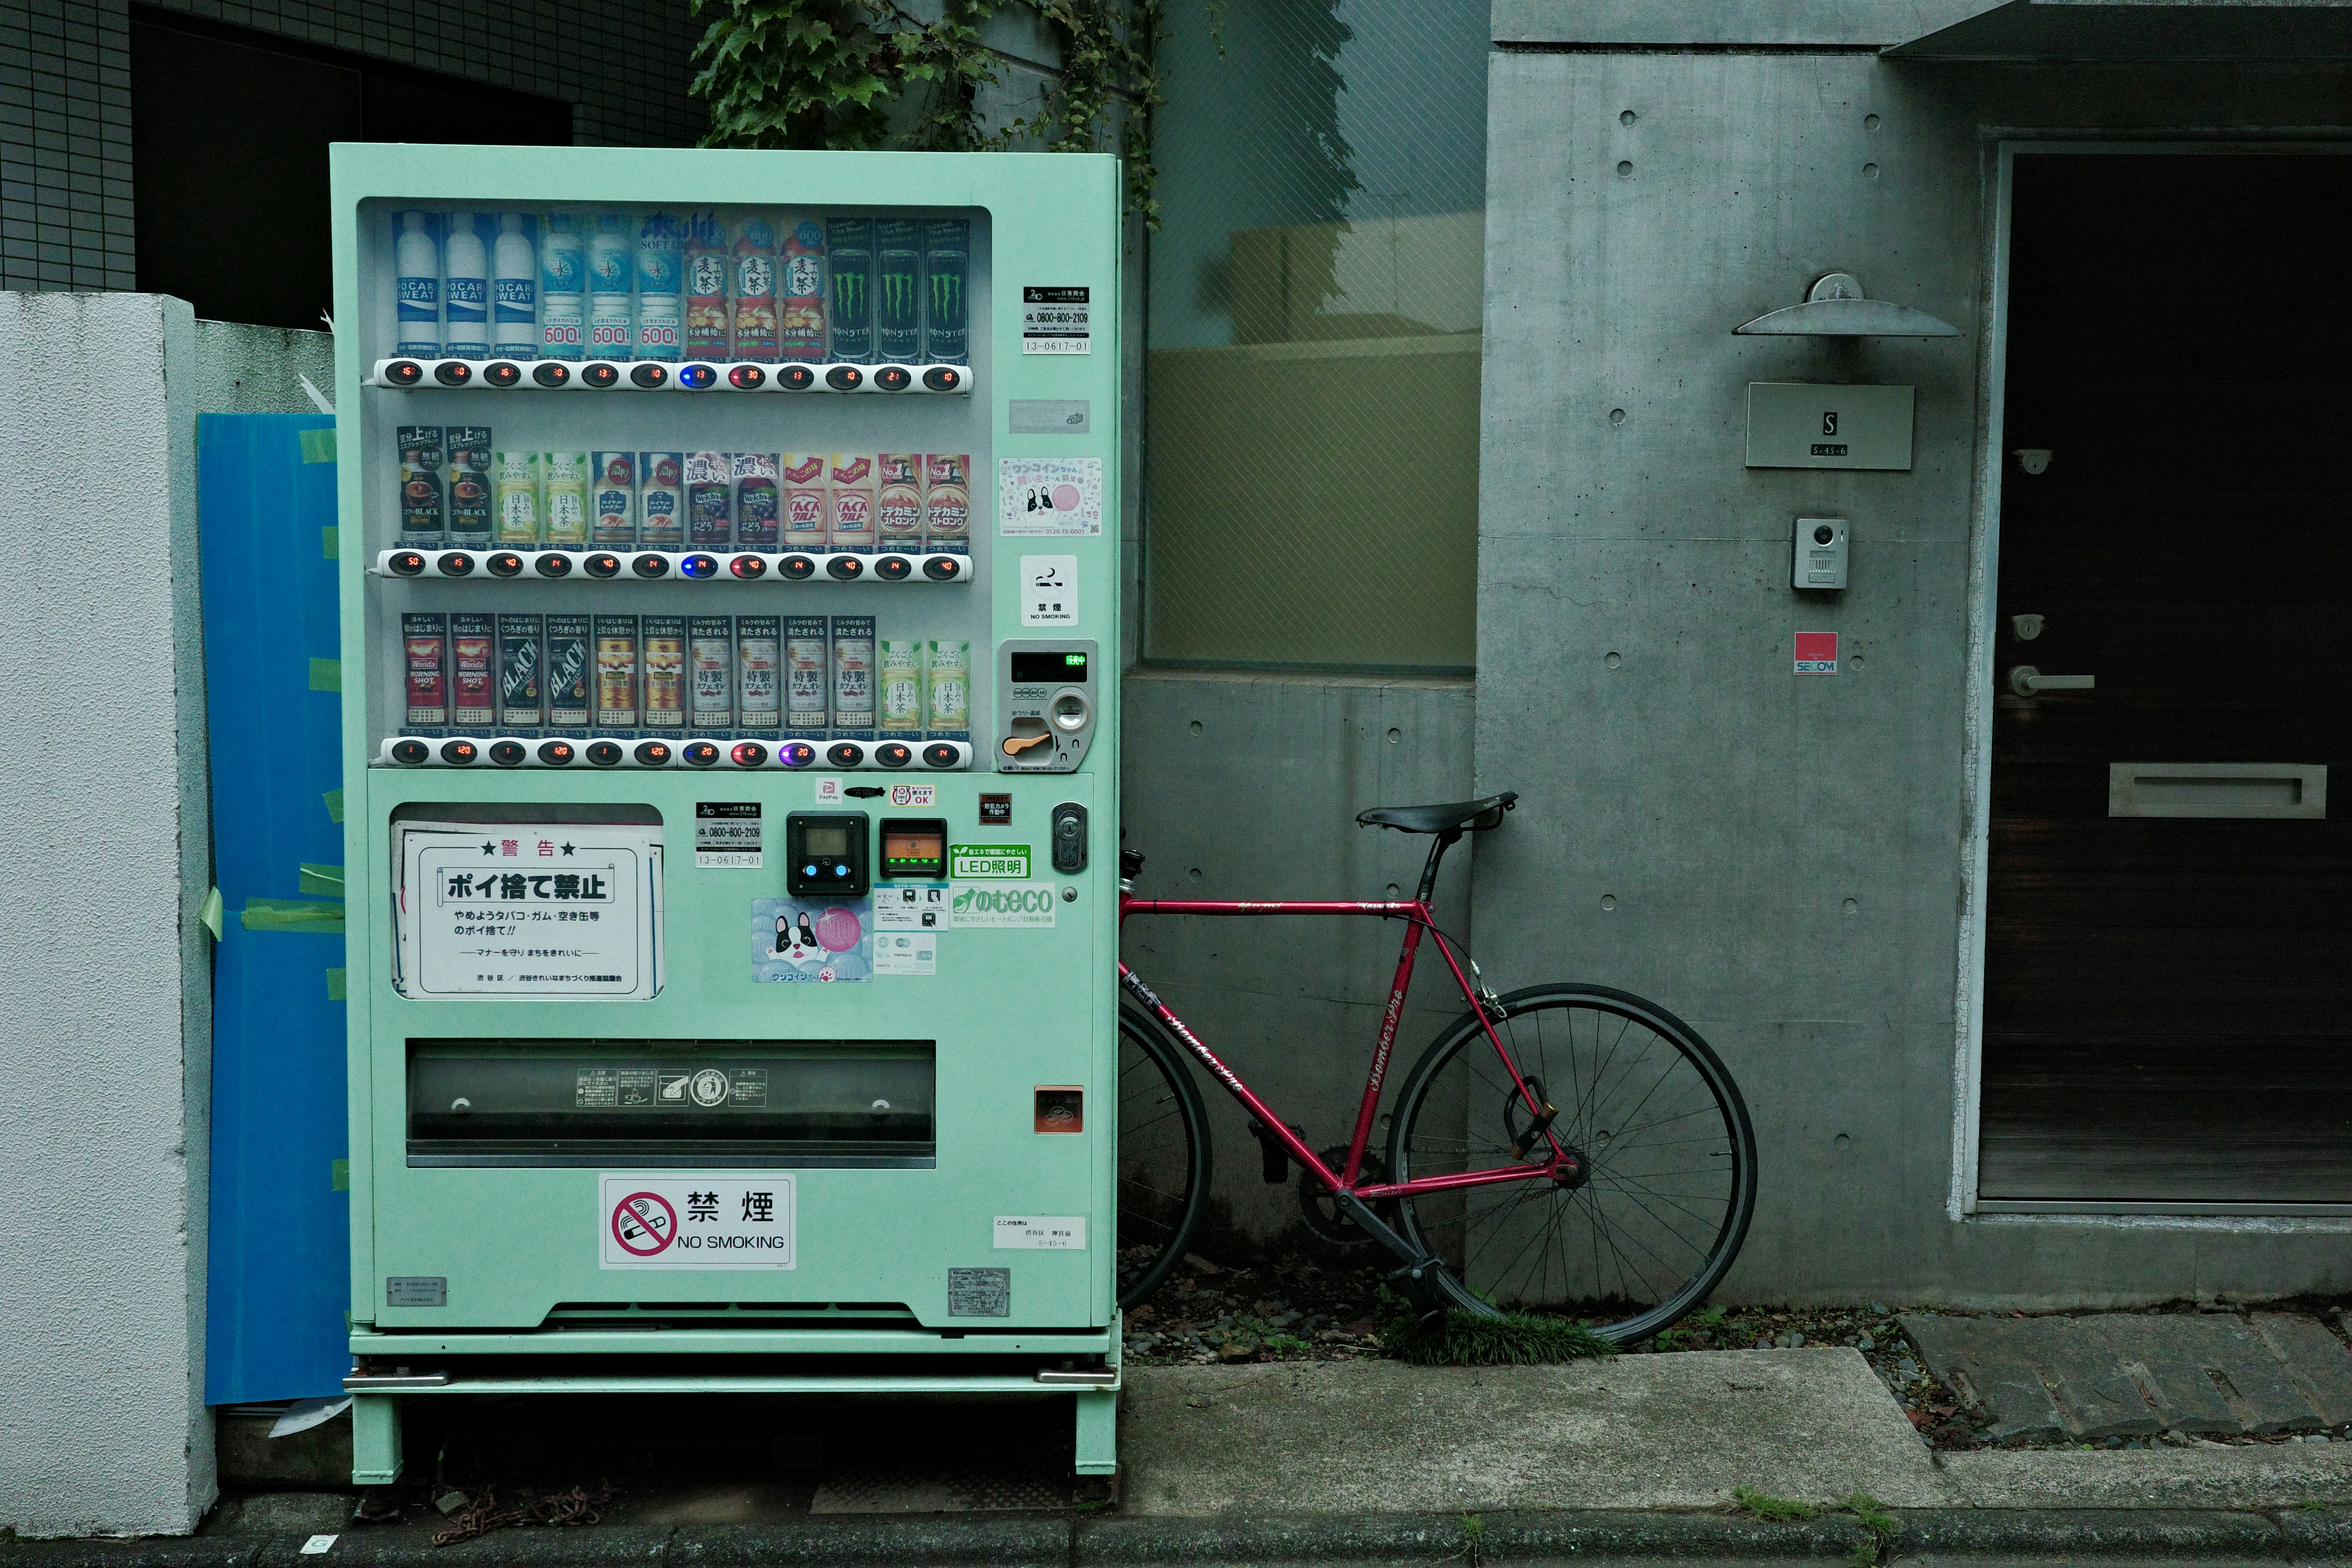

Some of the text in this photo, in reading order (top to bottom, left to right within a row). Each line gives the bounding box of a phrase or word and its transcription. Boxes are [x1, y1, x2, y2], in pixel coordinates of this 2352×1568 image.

[697, 258, 715, 294] 麦茶
[713, 260, 722, 288] 十六茶
[747, 258, 764, 294] 麦茶
[762, 260, 771, 288] 十六茶
[795, 258, 811, 295] 麦茶
[809, 260, 818, 288] 十六茶
[398, 283, 436, 291] POCARI
[447, 283, 485, 291] POCARI
[495, 283, 534, 292] POCARI
[398, 291, 434, 299] SWEAT
[447, 292, 482, 300] SWEAT
[495, 292, 531, 301] SWEAT
[1037, 313, 1087, 323] 0800-800-2109
[545, 327, 577, 343] 600
[593, 327, 625, 343] 600
[642, 327, 674, 343] 600
[689, 328, 726, 338] 水分補給に!
[737, 329, 775, 338] 水分補給に!
[785, 329, 822, 338] 水分補給に!
[1824, 415, 1834, 434] S
[422, 452, 439, 461] 無糖
[472, 453, 488, 461] 無糖
[505, 462, 528, 470] ごくごく
[686, 459, 725, 481] 濃い
[734, 456, 774, 475] 濃い
[800, 463, 819, 478] この味
[848, 463, 866, 478] この味
[882, 464, 903, 476] No.1
[930, 464, 950, 476] No.1
[499, 472, 535, 481] 飲みやすい
[548, 472, 583, 481] 飲みやすい
[611, 465, 629, 478] 濃厚
[659, 466, 677, 479] 濃厚
[697, 493, 720, 502] Welch's
[745, 493, 769, 503] Welch's
[511, 495, 522, 526] 日本茶
[559, 495, 570, 527] 日本茶
[693, 522, 712, 531] ぶどう
[741, 522, 760, 532] ぶどう
[931, 517, 964, 526] ストロング
[501, 625, 539, 633] くつろぎの香り
[549, 626, 587, 634] くつろぎの香り
[787, 628, 824, 636] 満たされる
[889, 650, 913, 659] ごくごく
[1066, 655, 1085, 665] 販売中
[412, 660, 436, 668] Wonda
[461, 660, 484, 668] Wonda
[503, 639, 538, 699] BLACK
[550, 639, 586, 699] BLACK
[883, 660, 918, 668] 飲みやすい
[931, 660, 966, 668] 飲みやすい
[1798, 662, 1834, 671] SECOM
[699, 671, 722, 682] 特製
[747, 671, 770, 682] 特製
[794, 670, 817, 683] 特製
[842, 670, 865, 683] 特製
[895, 683, 906, 715] 日本茶
[943, 683, 954, 714] 日本茶
[710, 828, 760, 837] 0800-800-2109
[960, 860, 1021, 874] LED照明
[448, 874, 606, 899] ポイ捨て禁止
[976, 889, 1053, 913] のむeco
[455, 911, 599, 921] やめようタバコ・ガム・空き缶等
[1368, 990, 1403, 1091] Bomber Pro
[1165, 1017, 1243, 1092] Bomber Pro
[697, 1095, 721, 1103] リサイクル
[678, 1236, 784, 1248] NO SMOKING
